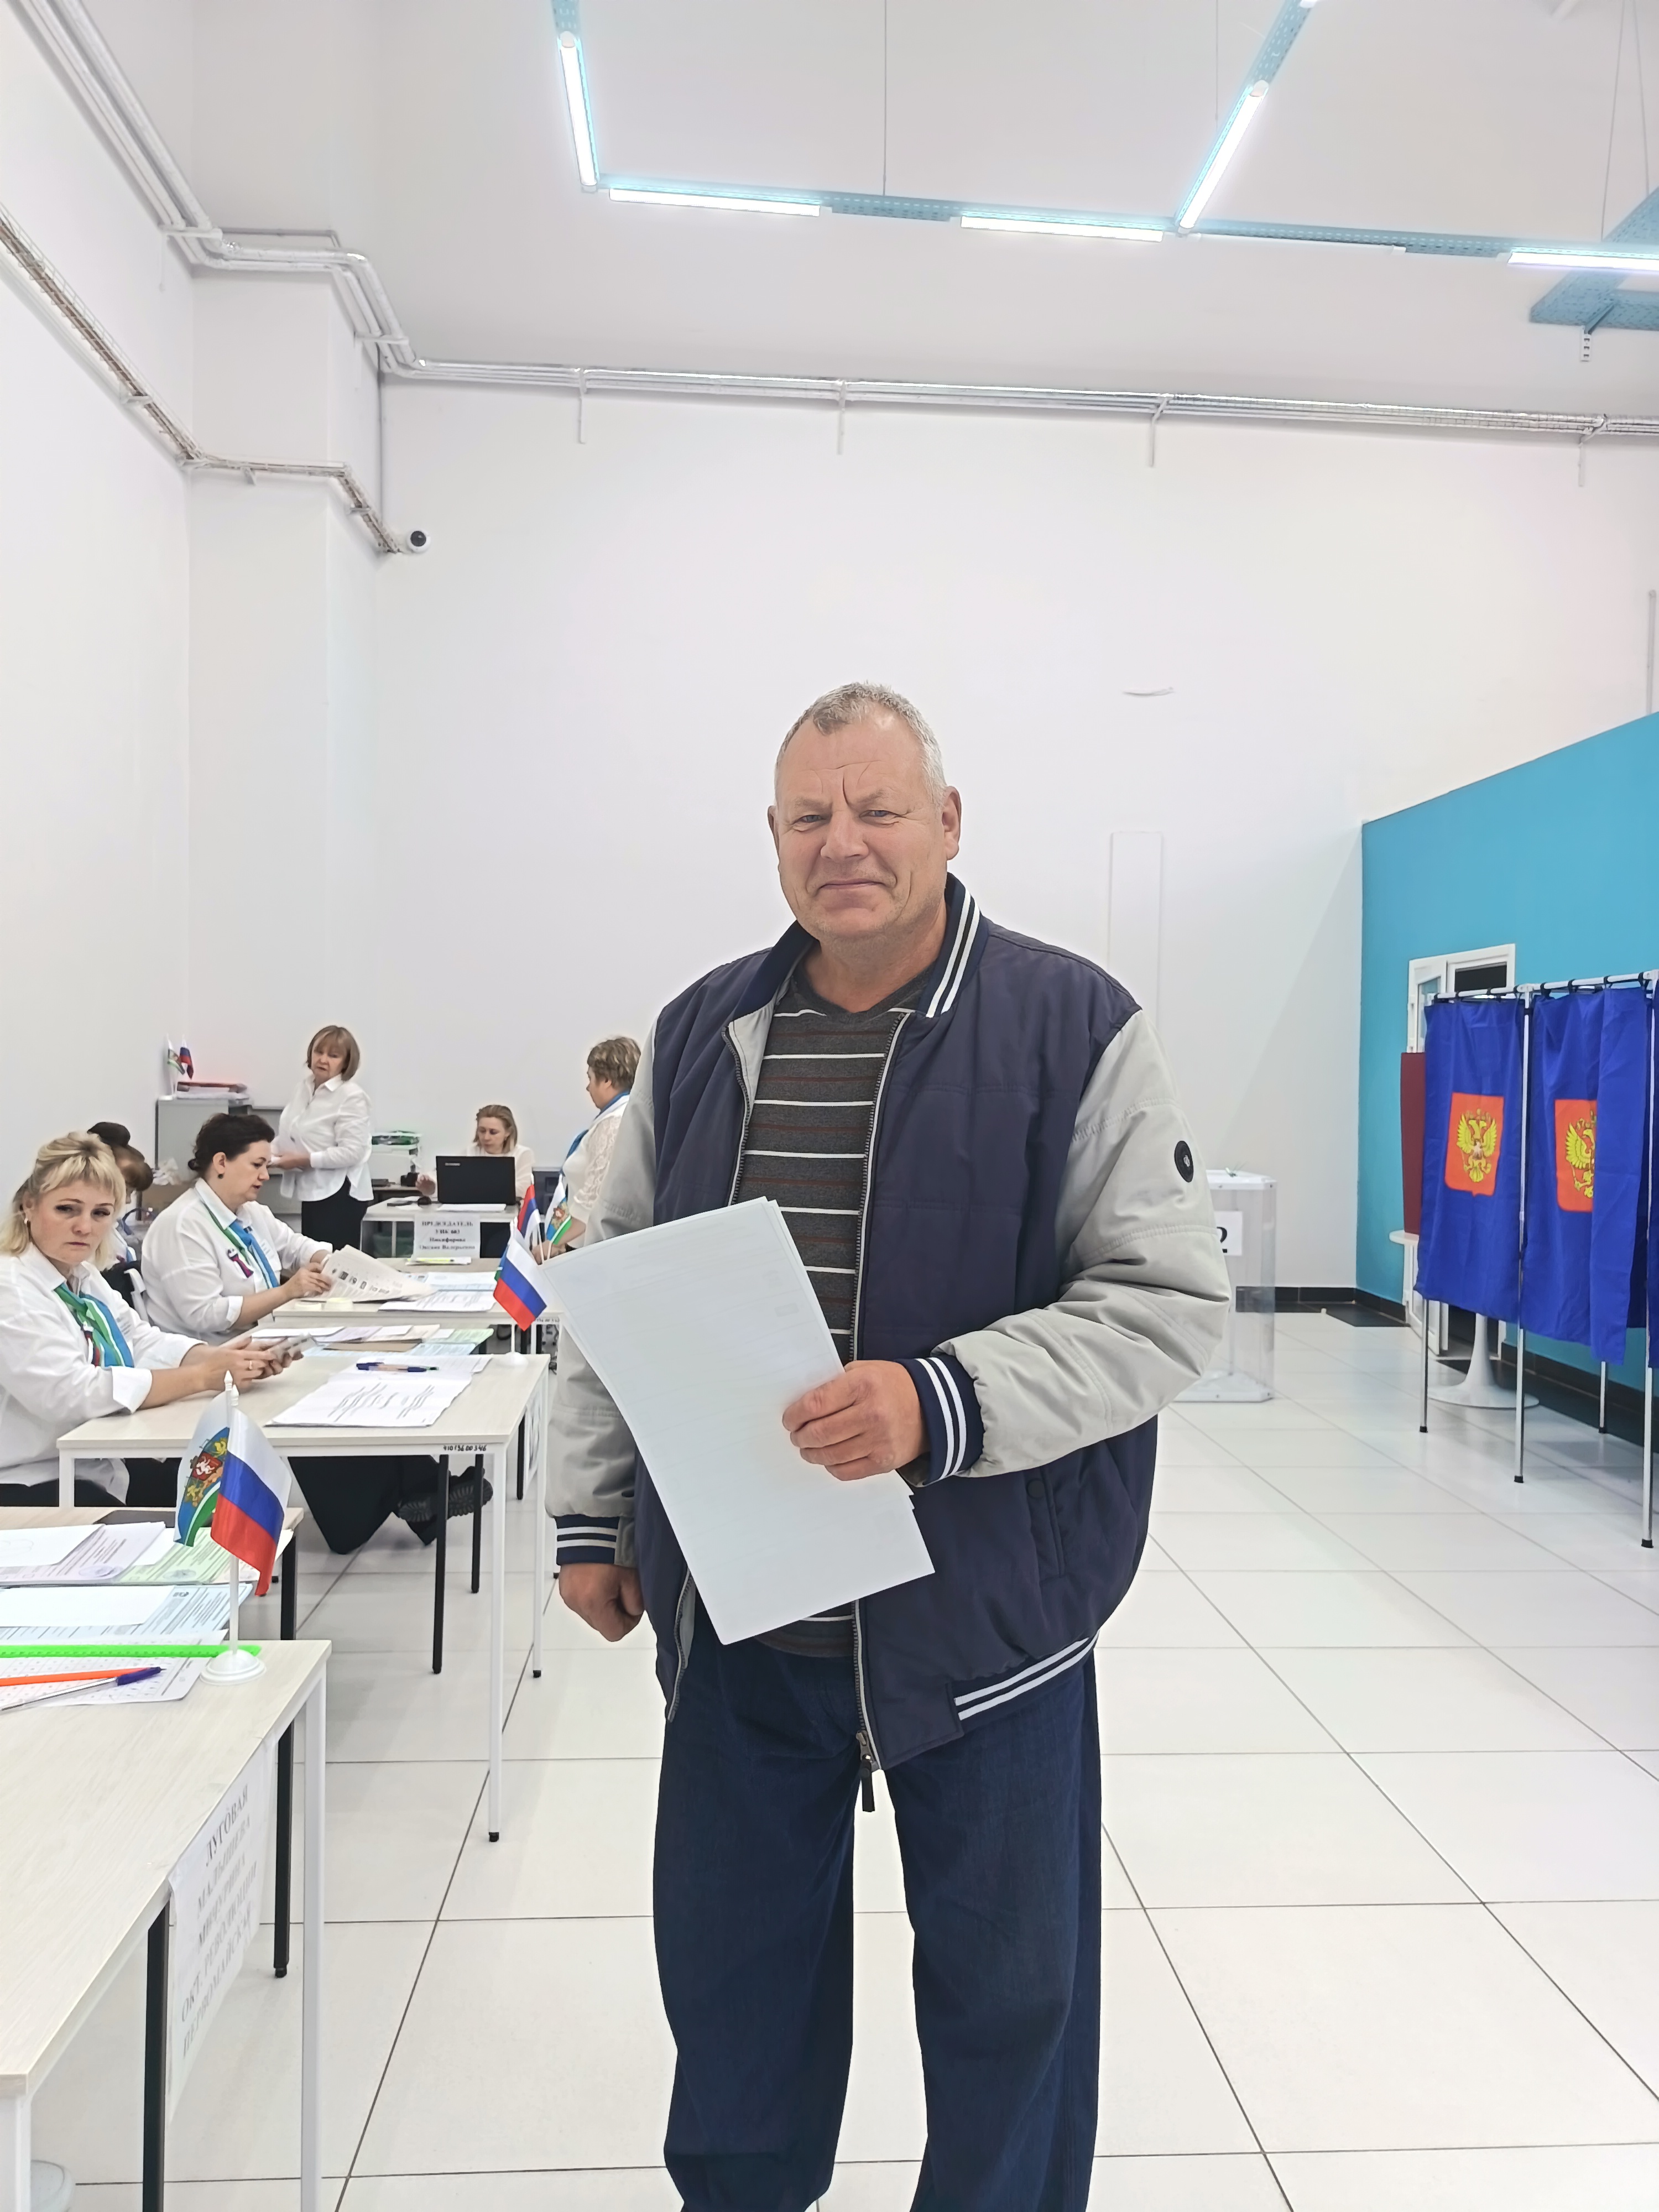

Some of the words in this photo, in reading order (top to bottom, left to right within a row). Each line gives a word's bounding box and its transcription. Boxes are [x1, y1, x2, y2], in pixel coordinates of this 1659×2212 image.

[197, 1812, 251, 1920] МАЛЫШЕВА
[206, 1782, 248, 1867] ЛУГОВАЯ
[181, 1969, 203, 2022] ОКТ.
[205, 1859, 257, 1976] РЕВОЛЮЦИИ
[197, 1851, 246, 1954] МИЧУРИНА
[183, 1898, 251, 2058] ПЕРВОМАЙСКАЯ
